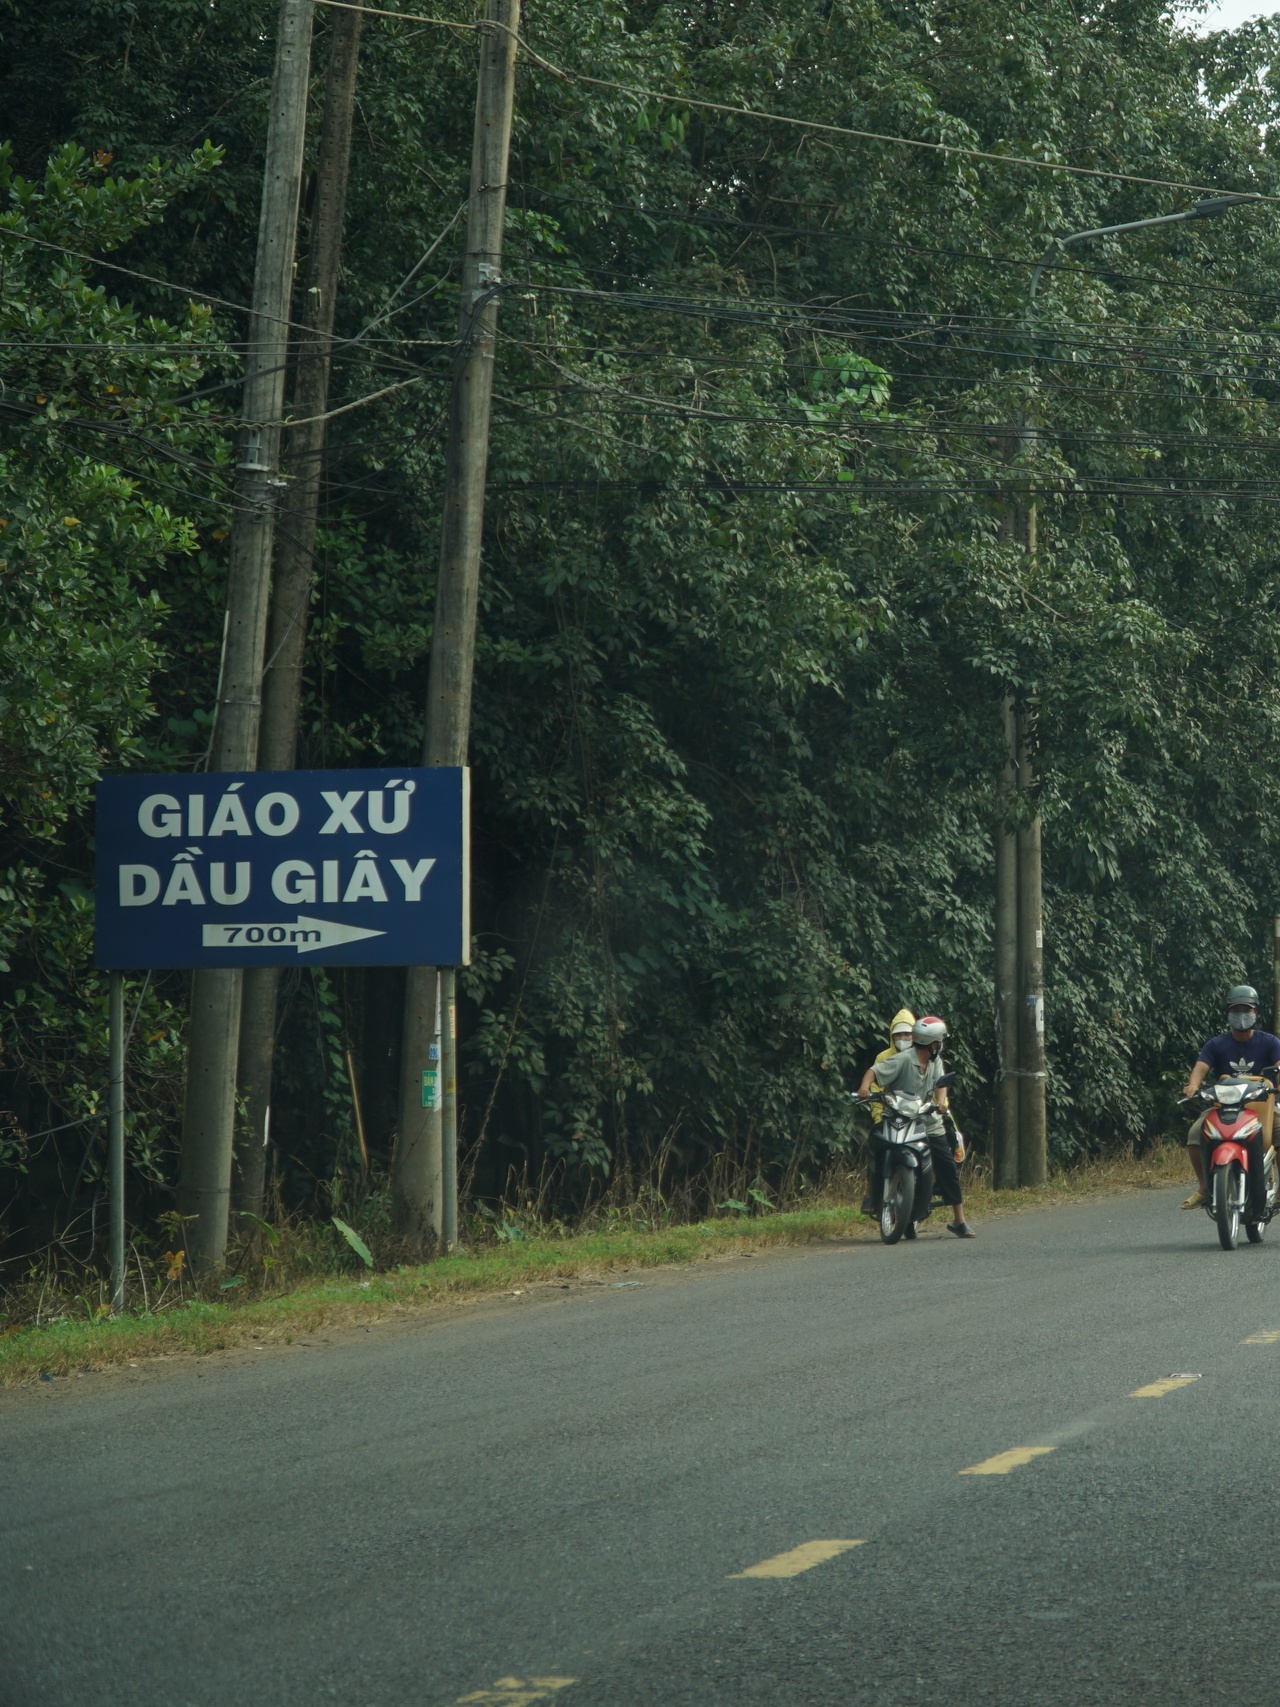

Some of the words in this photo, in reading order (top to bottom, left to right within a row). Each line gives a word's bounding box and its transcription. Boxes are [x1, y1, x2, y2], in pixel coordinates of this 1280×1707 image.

[137, 782, 300, 838] GIÁO
[318, 779, 416, 835] XỨ
[118, 846, 251, 907] DẦU
[270, 849, 437, 905] GIÂY
[222, 926, 322, 944] 700m
